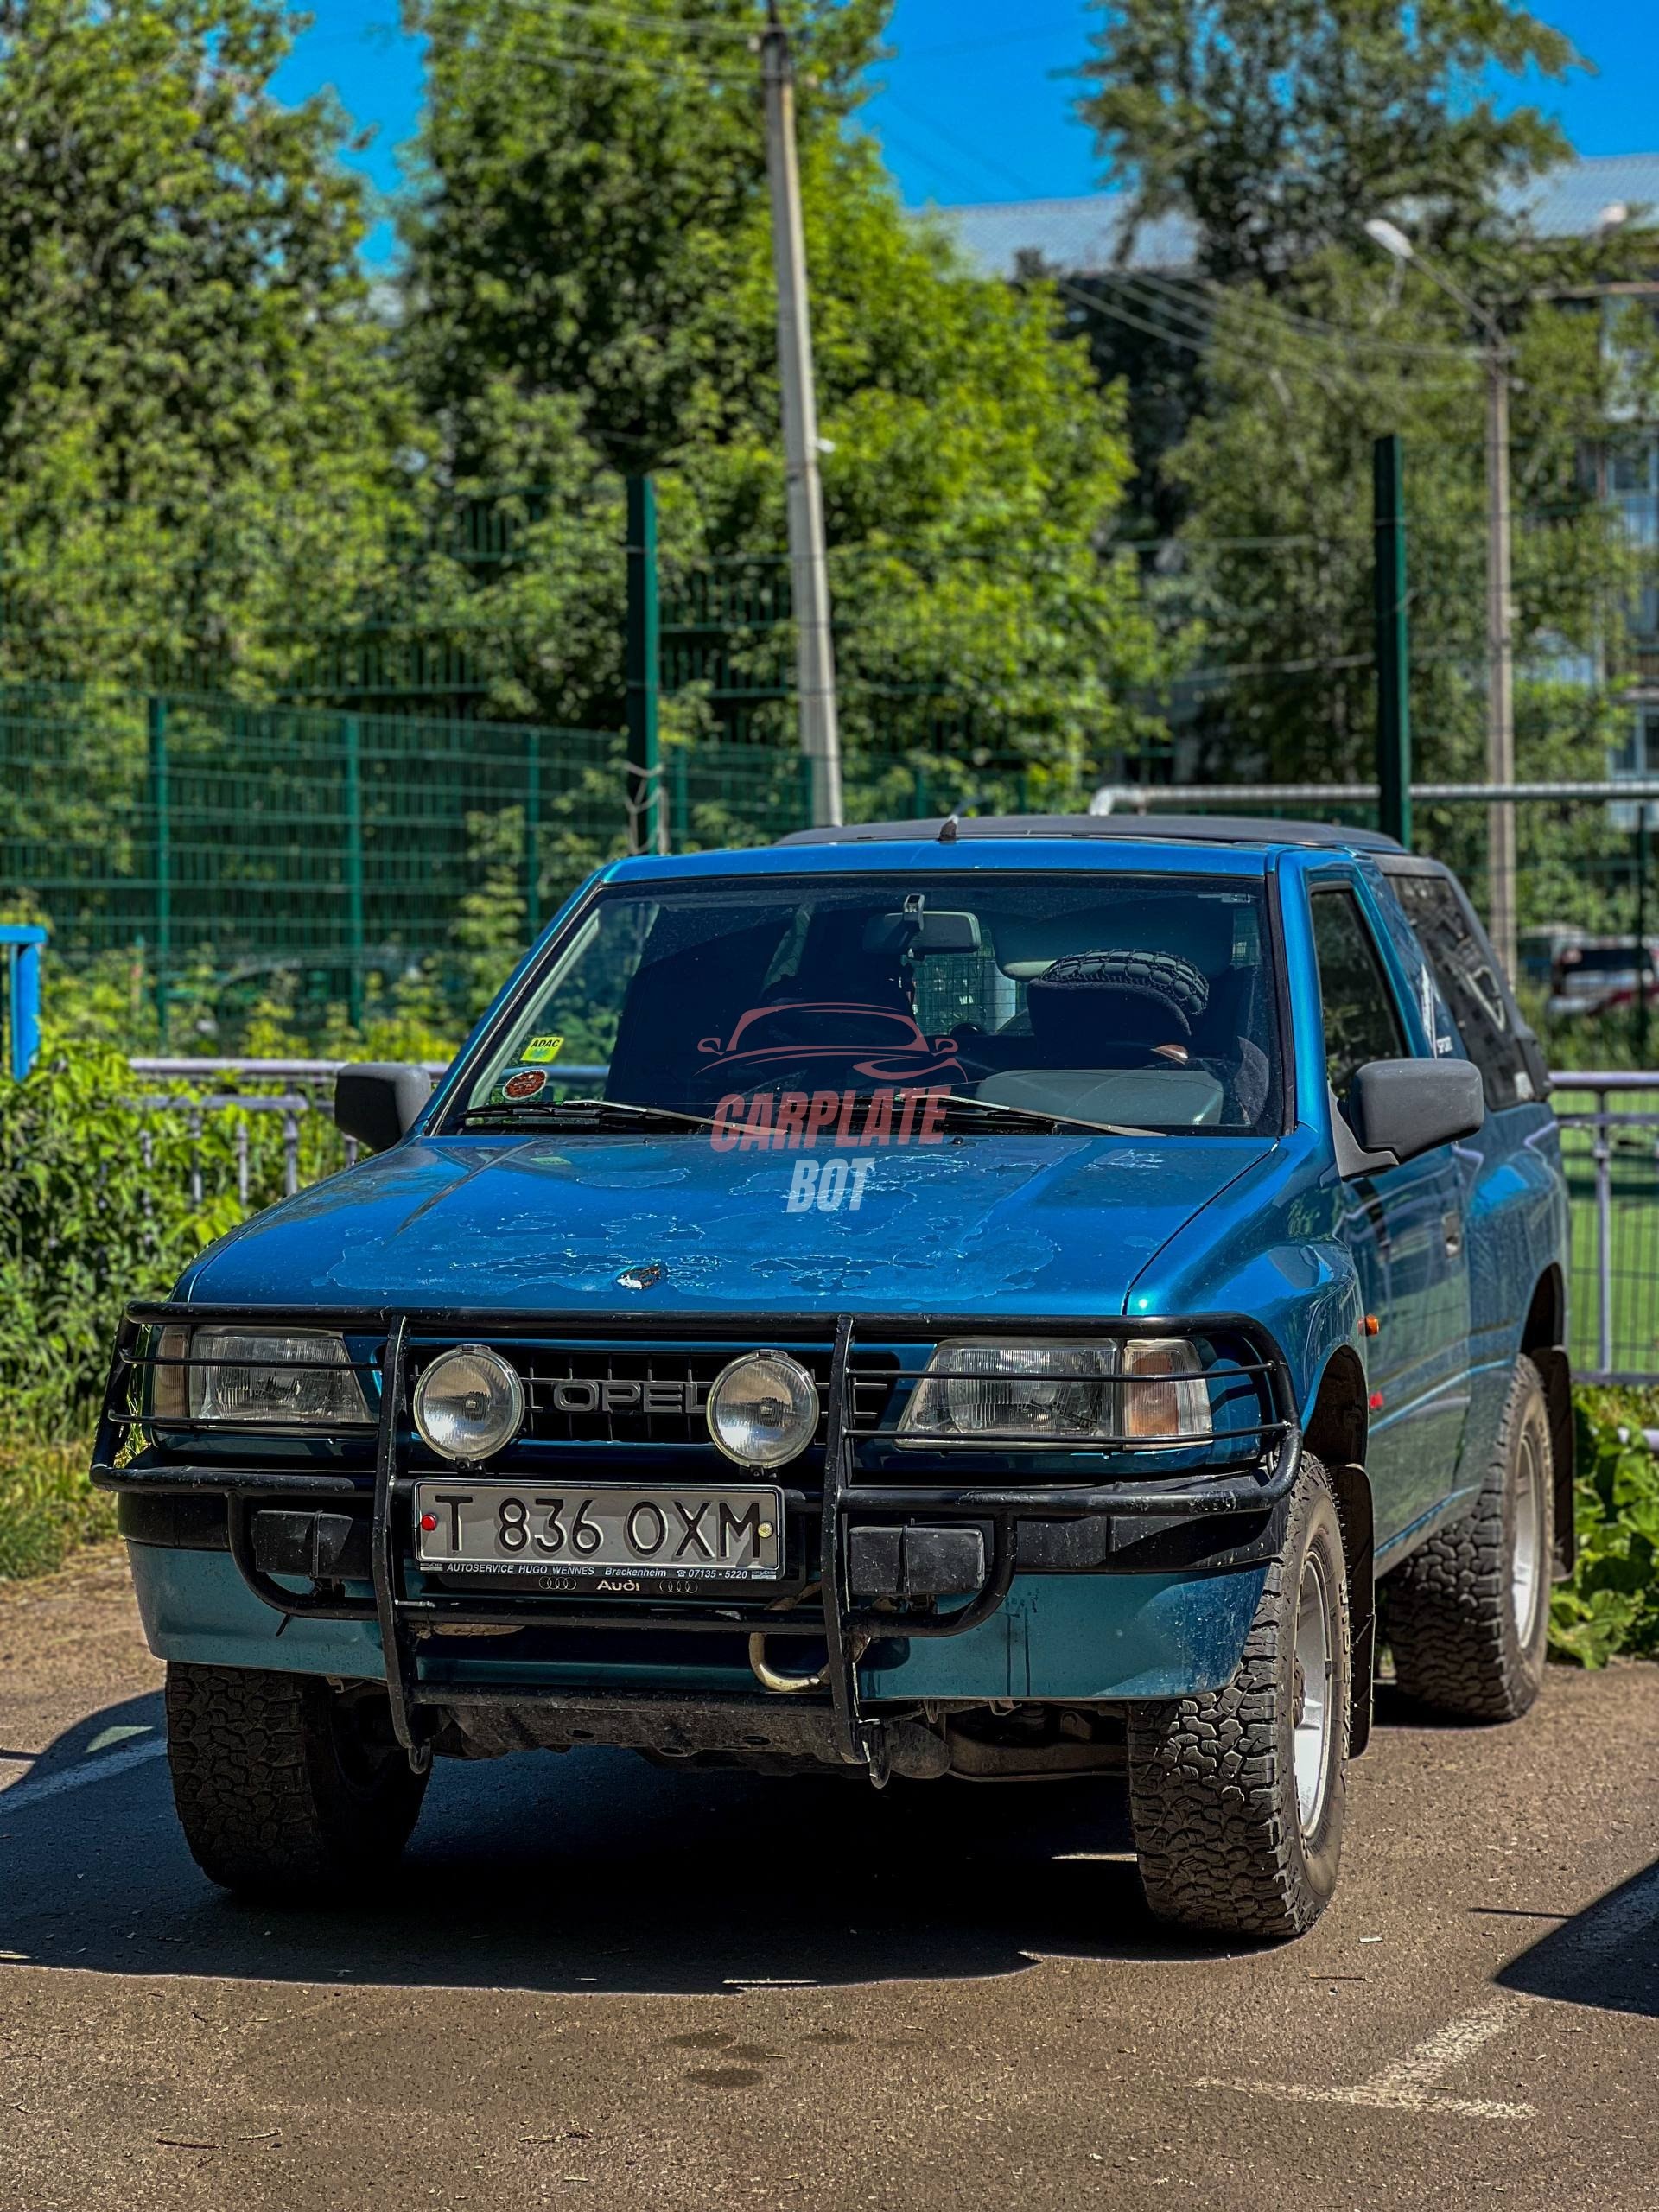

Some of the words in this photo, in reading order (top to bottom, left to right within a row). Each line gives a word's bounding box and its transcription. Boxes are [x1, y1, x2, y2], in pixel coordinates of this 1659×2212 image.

[530, 1039, 561, 1048] ADAC
[553, 1380, 707, 1414] OPEL
[434, 1494, 474, 1553] T
[498, 1497, 603, 1554] 836
[626, 1500, 761, 1559] OXM
[446, 1563, 514, 1574] AUTOSERVICE
[518, 1565, 548, 1574] HUGO
[551, 1566, 595, 1576] WENNES
[604, 1567, 667, 1577] Brackenheim
[688, 1569, 716, 1579] 07135
[724, 1570, 748, 1580] 5220
[595, 1579, 640, 1592] Audi
